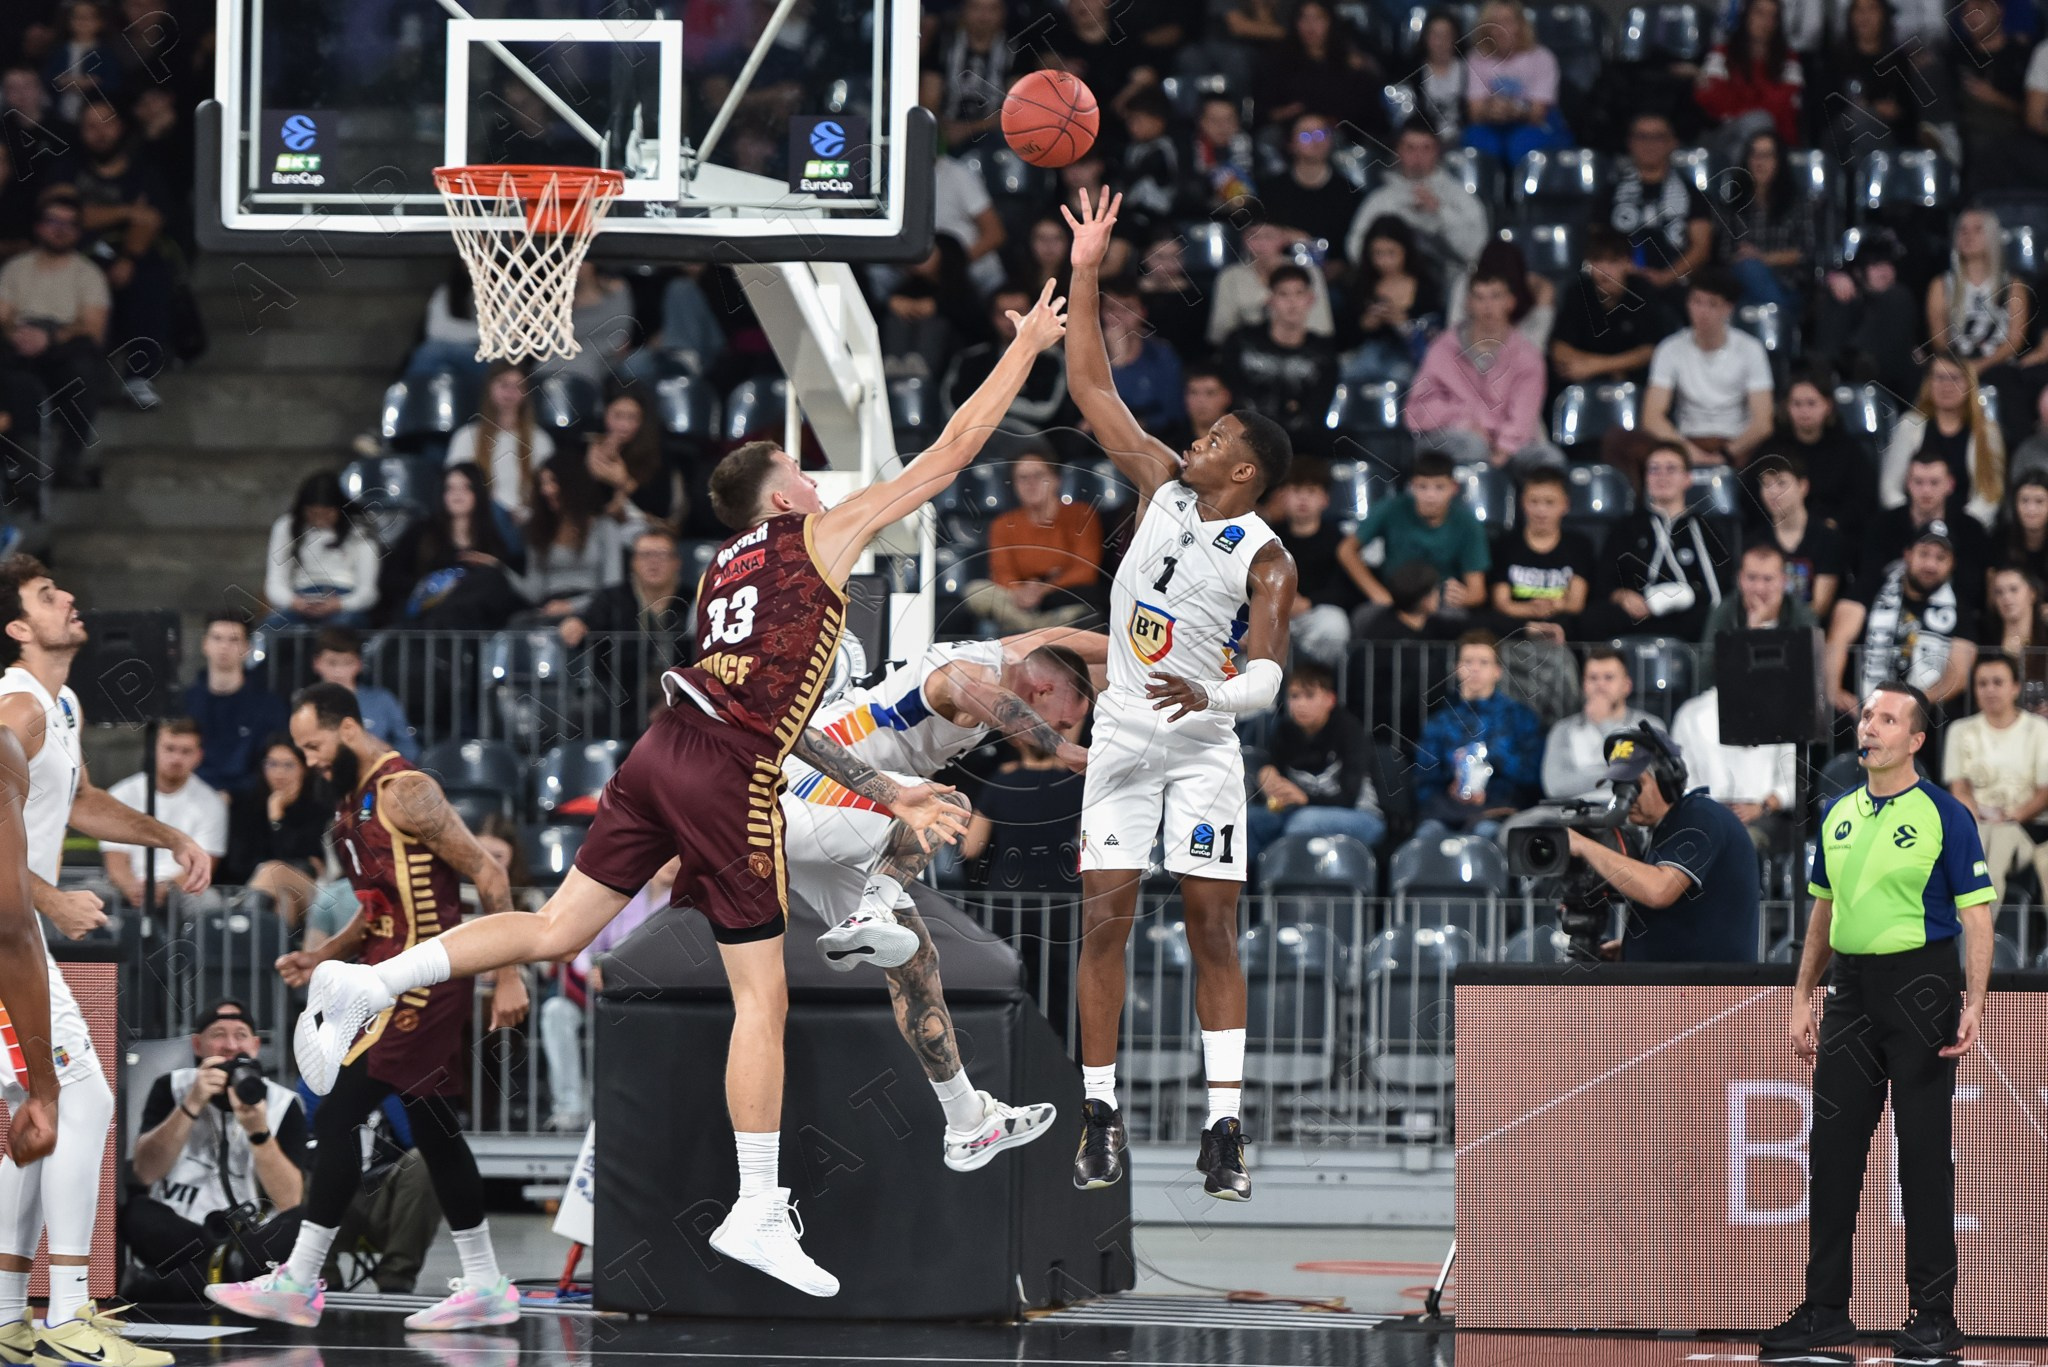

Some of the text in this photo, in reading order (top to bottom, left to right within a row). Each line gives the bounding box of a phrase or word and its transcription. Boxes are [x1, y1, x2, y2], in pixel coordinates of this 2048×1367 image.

[272, 172, 325, 187] EuroCup
[800, 178, 853, 193] EuroCup
[1153, 556, 1178, 594] 1
[1135, 615, 1165, 642] BT
[1219, 824, 1234, 864] 1
